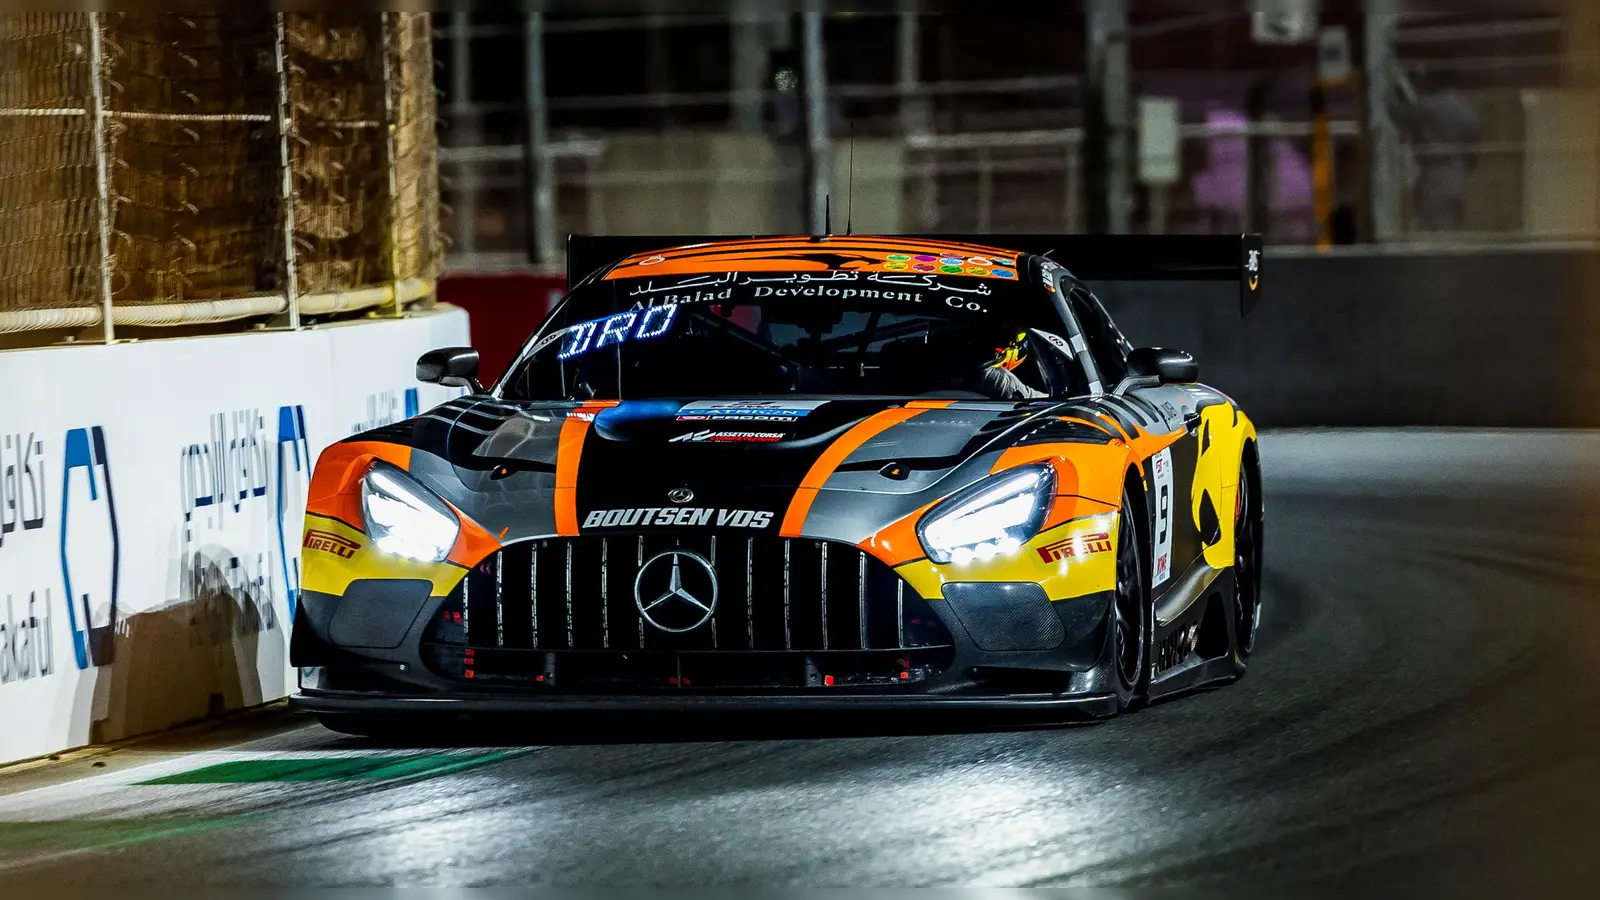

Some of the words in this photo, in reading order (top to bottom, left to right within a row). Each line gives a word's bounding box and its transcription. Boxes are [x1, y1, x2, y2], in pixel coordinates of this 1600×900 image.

[866, 270, 992, 296] شركة
[663, 288, 732, 308] Balad
[754, 286, 923, 303] Development
[945, 295, 989, 313] Co.
[582, 507, 714, 528] BOUTSEN
[716, 508, 774, 528] VDS
[1159, 484, 1168, 545] 9
[303, 529, 361, 560] PIRELLI
